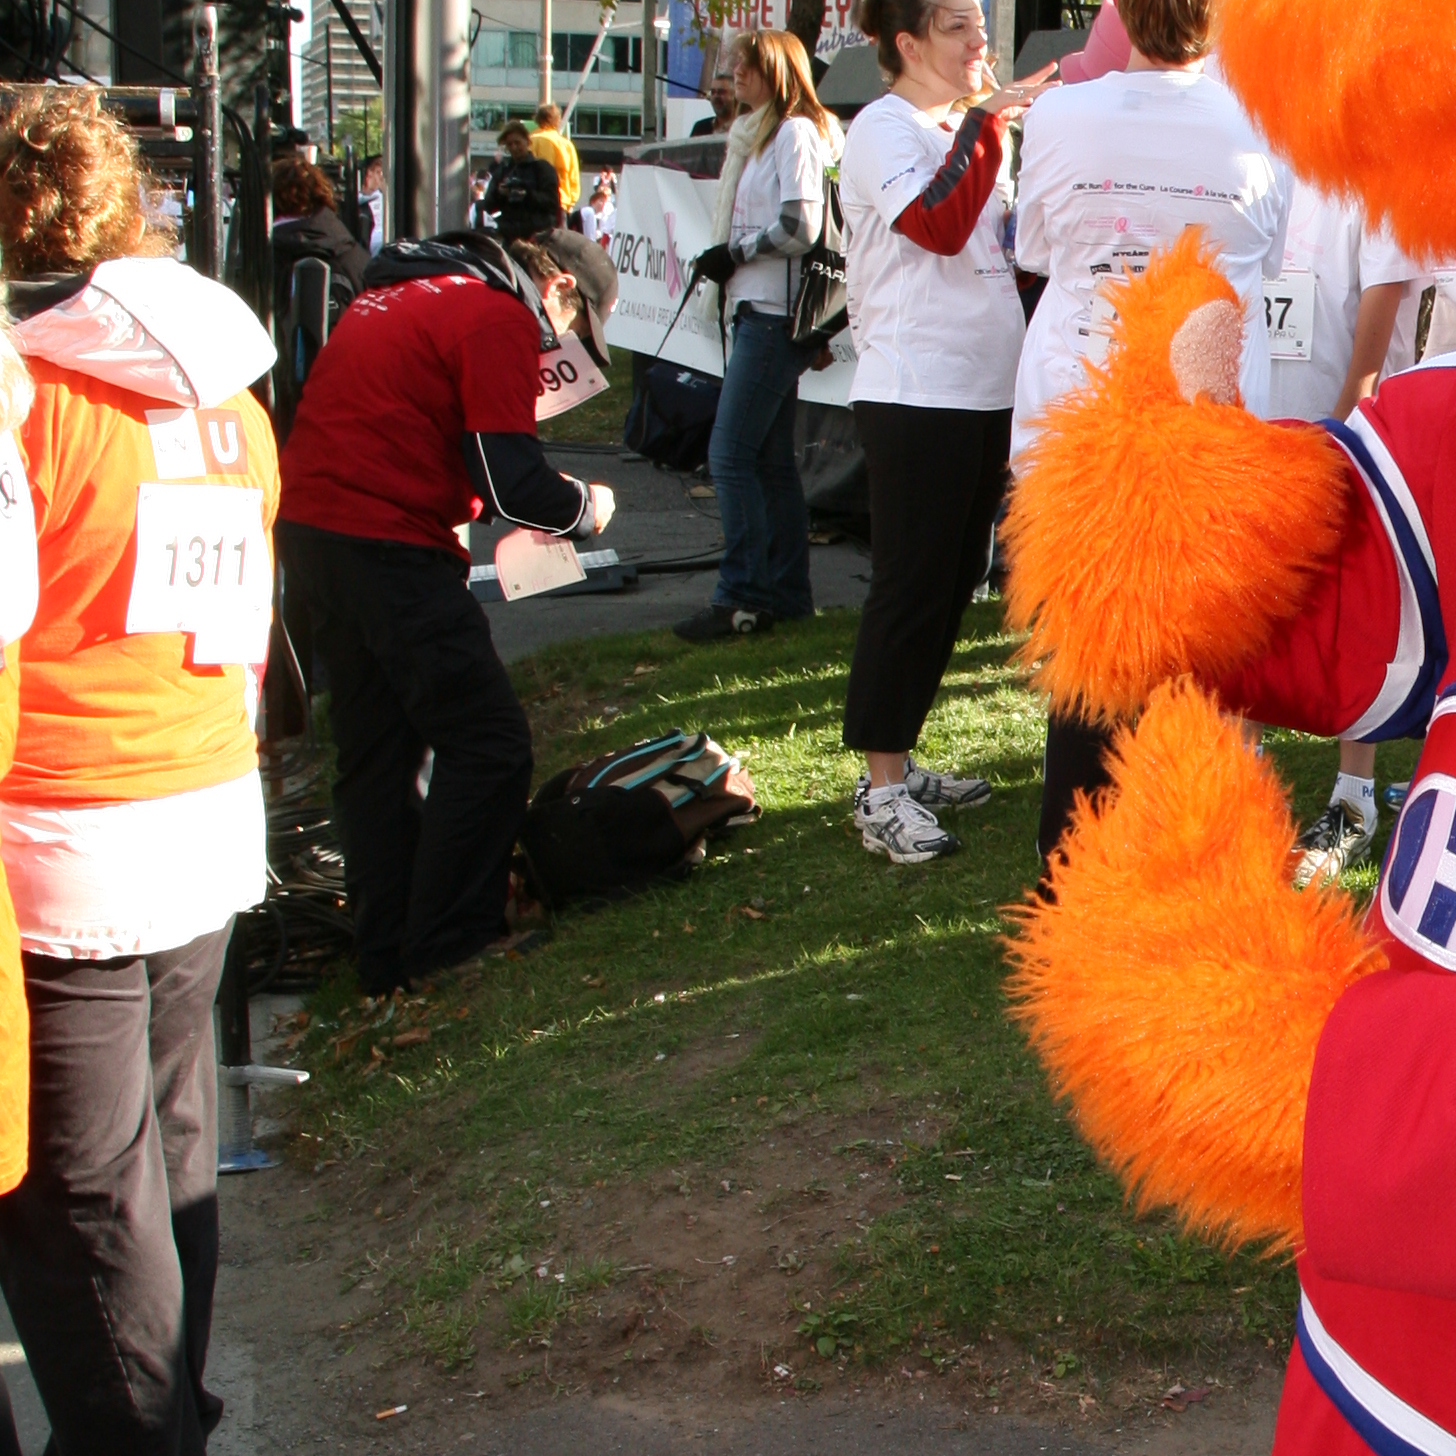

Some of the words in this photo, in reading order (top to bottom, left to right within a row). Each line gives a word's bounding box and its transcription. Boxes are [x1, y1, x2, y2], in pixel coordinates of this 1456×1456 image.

[1114, 182, 1125, 190] for
[1126, 183, 1137, 191] the
[1138, 183, 1156, 192] Cure
[1159, 185, 1168, 193] La
[1169, 185, 1194, 195] Course
[610, 231, 644, 277] CIBC
[644, 235, 667, 282] Run
[165, 535, 247, 588] 1311
